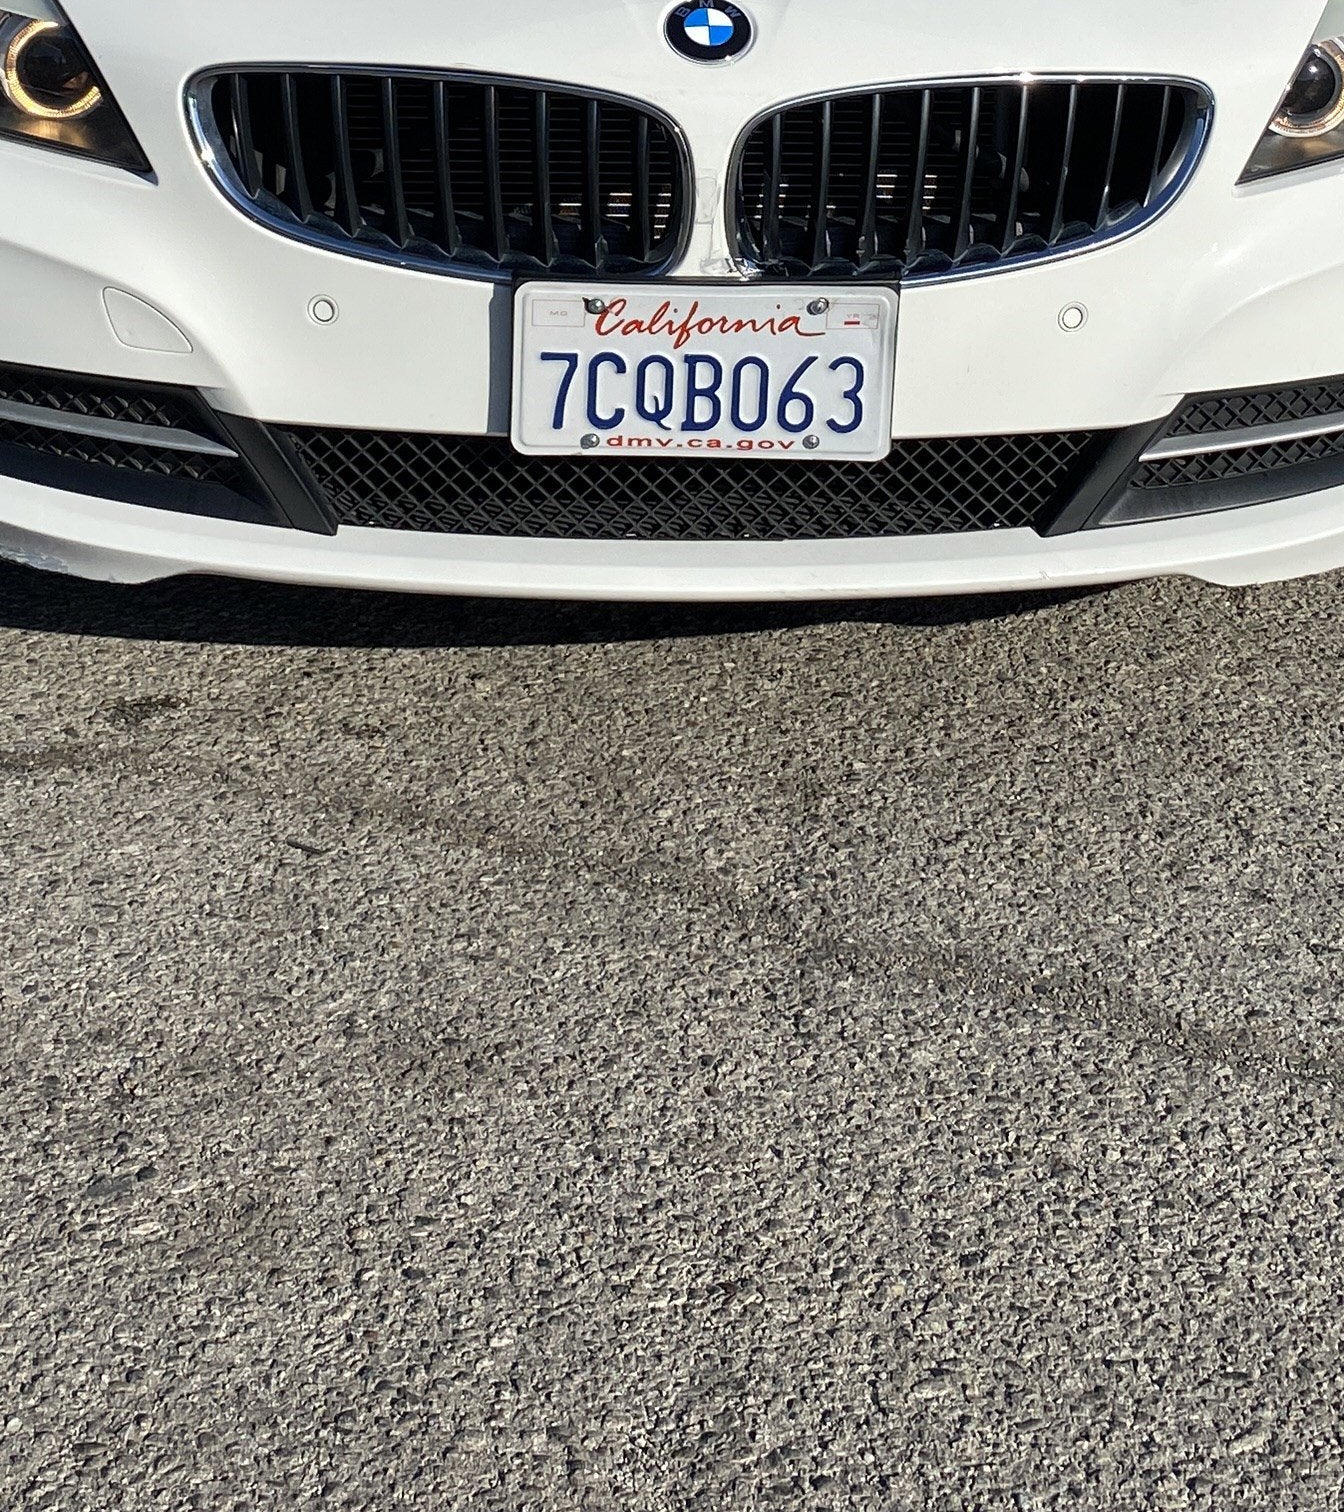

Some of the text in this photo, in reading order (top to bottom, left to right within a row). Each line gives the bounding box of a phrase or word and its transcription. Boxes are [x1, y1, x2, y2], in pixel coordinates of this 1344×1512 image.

[675, 0, 742, 18] BMW
[594, 298, 826, 349] California
[540, 352, 865, 434] 7CQB063
[606, 434, 796, 451] dmv.ca.gov
